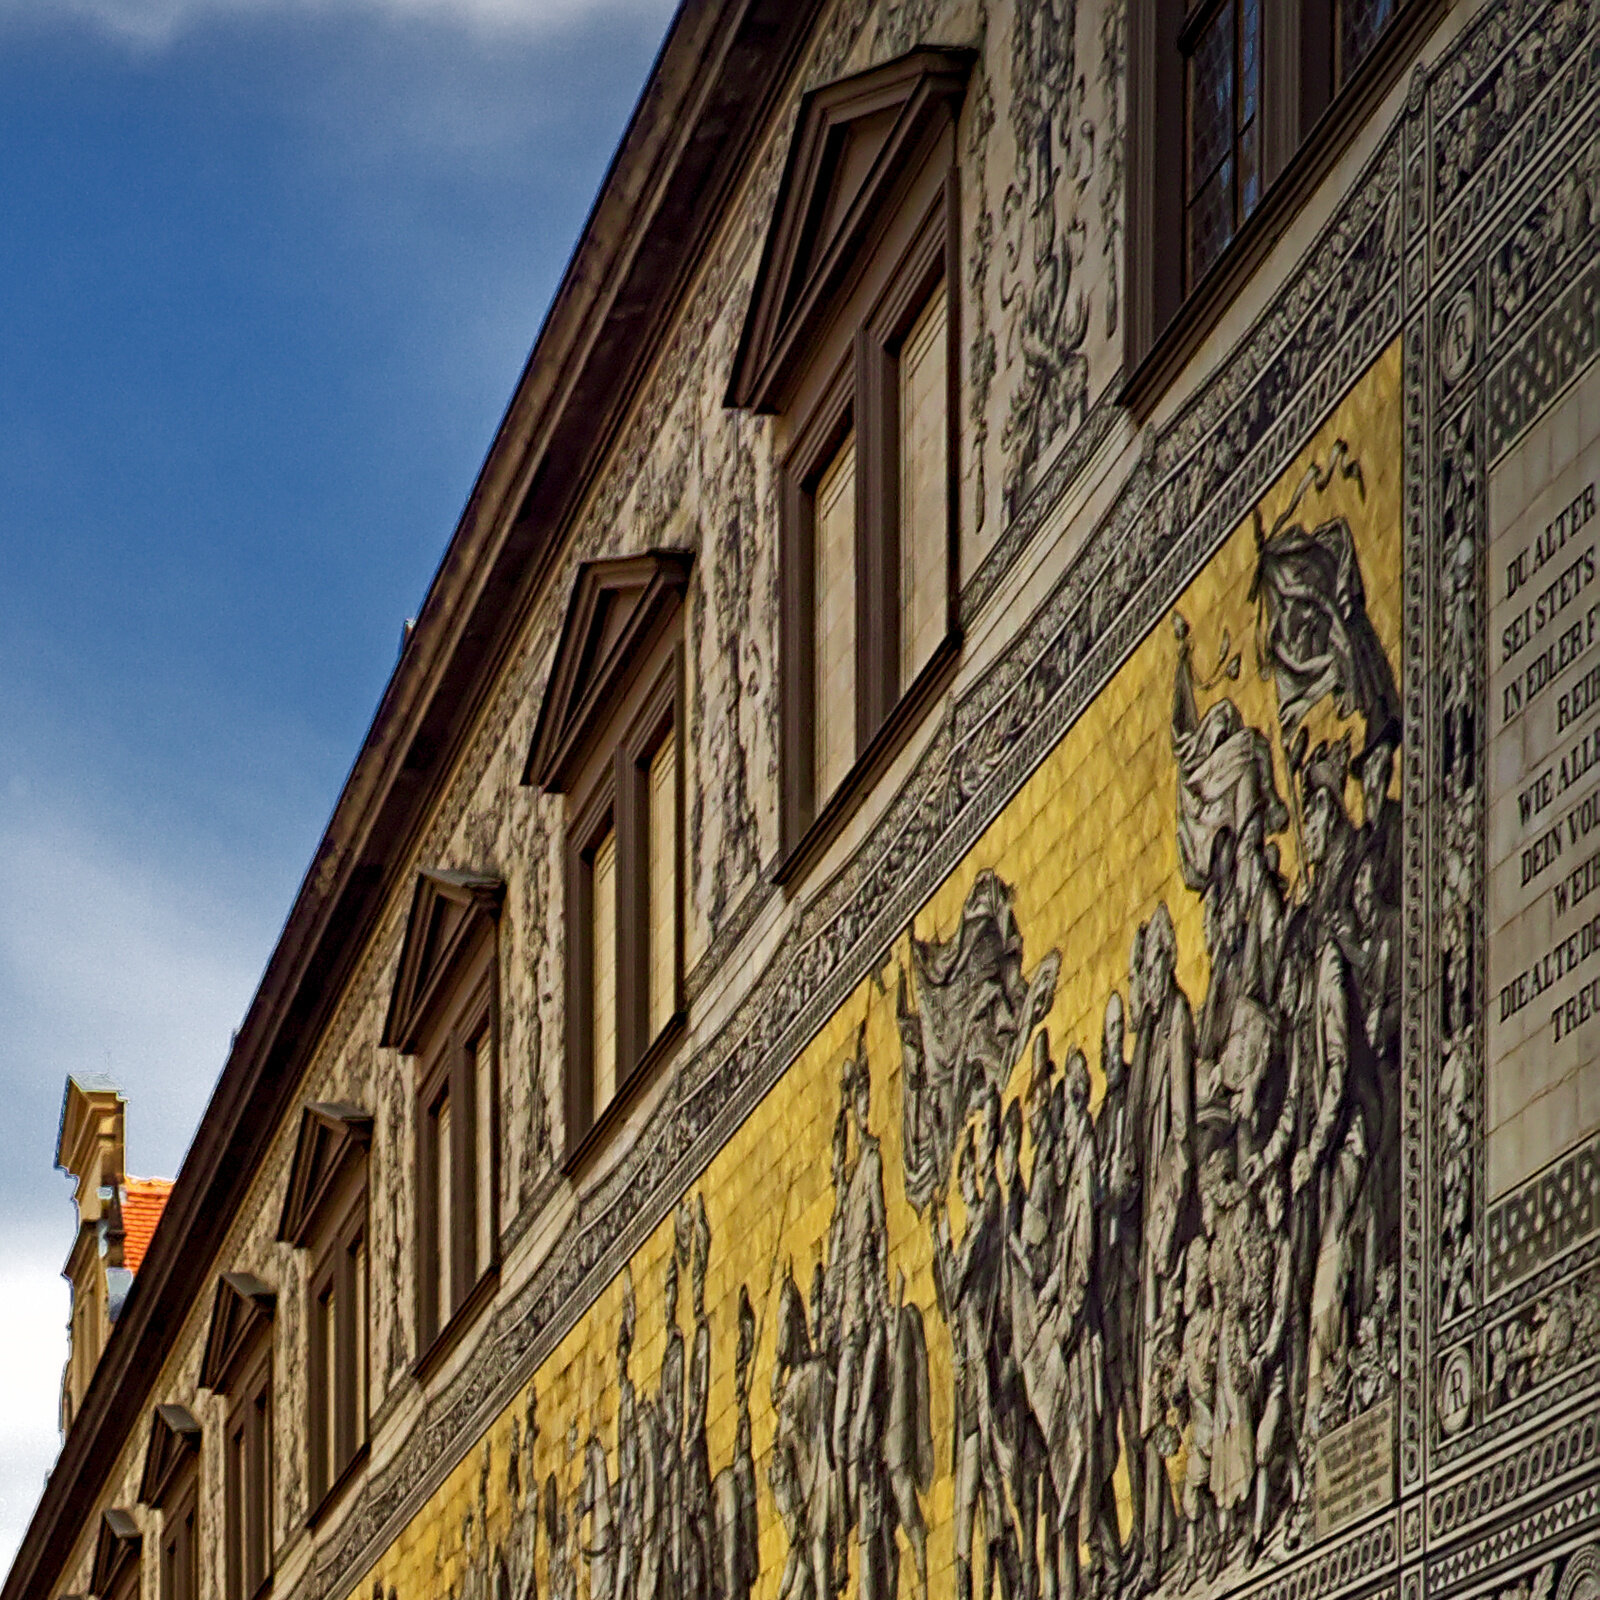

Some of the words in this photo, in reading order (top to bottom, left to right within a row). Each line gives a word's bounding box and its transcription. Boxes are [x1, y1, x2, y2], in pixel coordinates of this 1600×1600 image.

[1506, 546, 1530, 600] DU
[1532, 482, 1596, 574] ALTER
[1503, 606, 1531, 665] SEI
[1535, 545, 1596, 633] STETS
[1503, 674, 1524, 723] IN
[1526, 620, 1584, 701] EDLER
[1518, 767, 1553, 827] WIE
[1520, 821, 1564, 889] DEIN
[1500, 970, 1528, 1024] DIE
[1530, 931, 1579, 1001] ALTE
